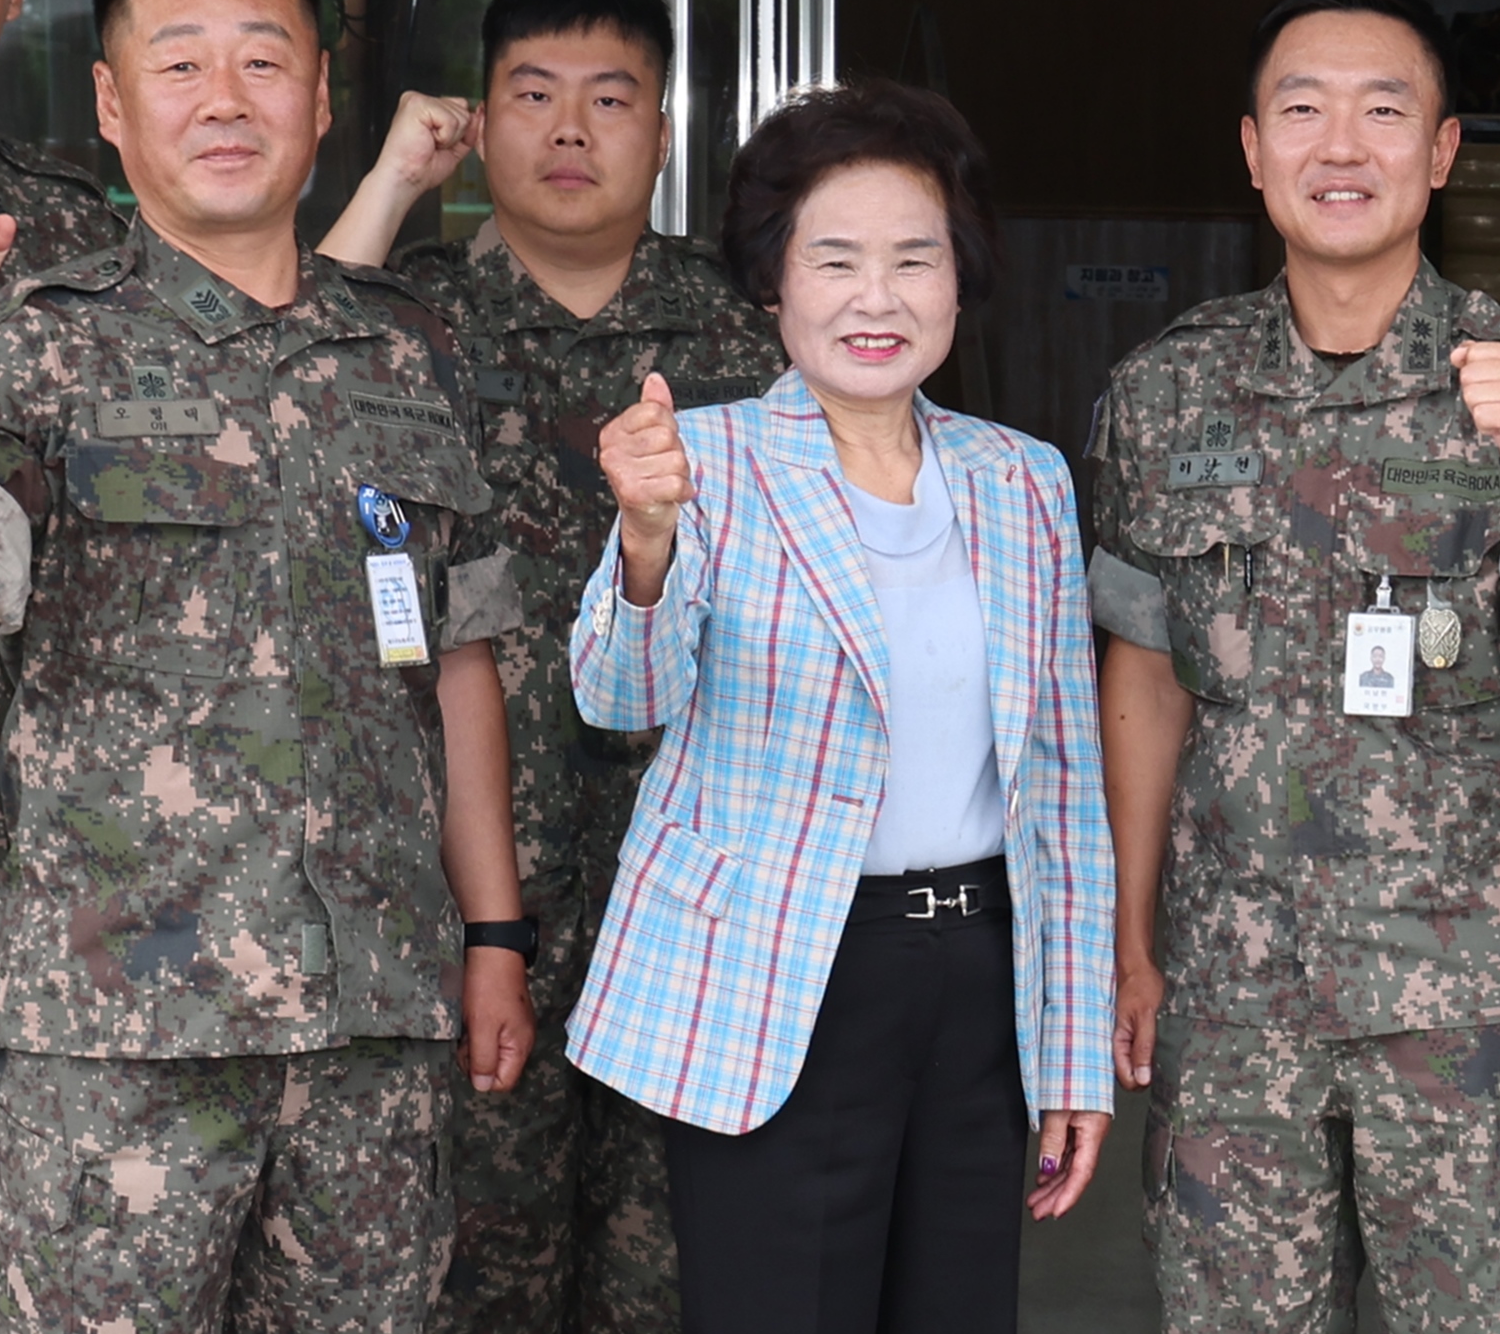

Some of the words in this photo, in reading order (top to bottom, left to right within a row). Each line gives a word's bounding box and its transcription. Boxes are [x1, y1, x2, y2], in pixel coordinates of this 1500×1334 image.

[354, 398, 401, 419] 대한민국
[403, 404, 427, 424] 육군
[1386, 467, 1440, 485] 대한민국
[1443, 468, 1467, 487] 육군
